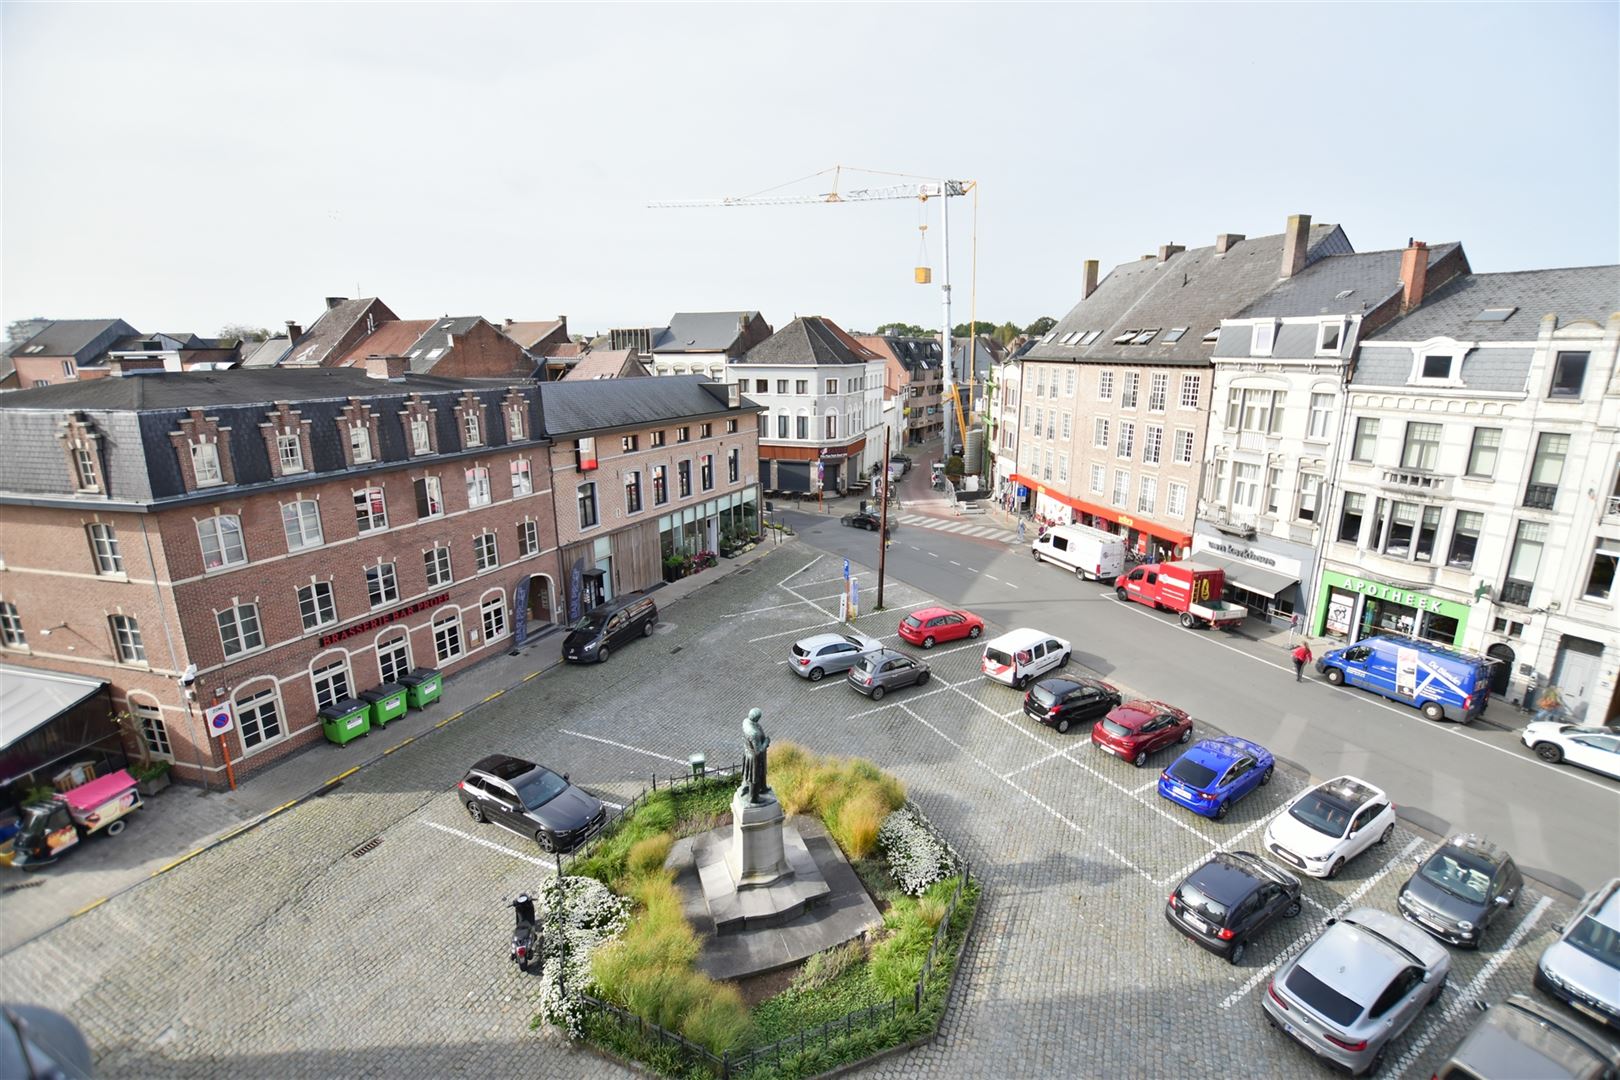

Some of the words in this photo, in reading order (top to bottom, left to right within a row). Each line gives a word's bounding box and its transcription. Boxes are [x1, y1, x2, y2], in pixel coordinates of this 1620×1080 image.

[1343, 578, 1443, 613] APOTHEEK
[322, 614, 391, 648] BRASSERIE
[392, 606, 415, 622] BAR
